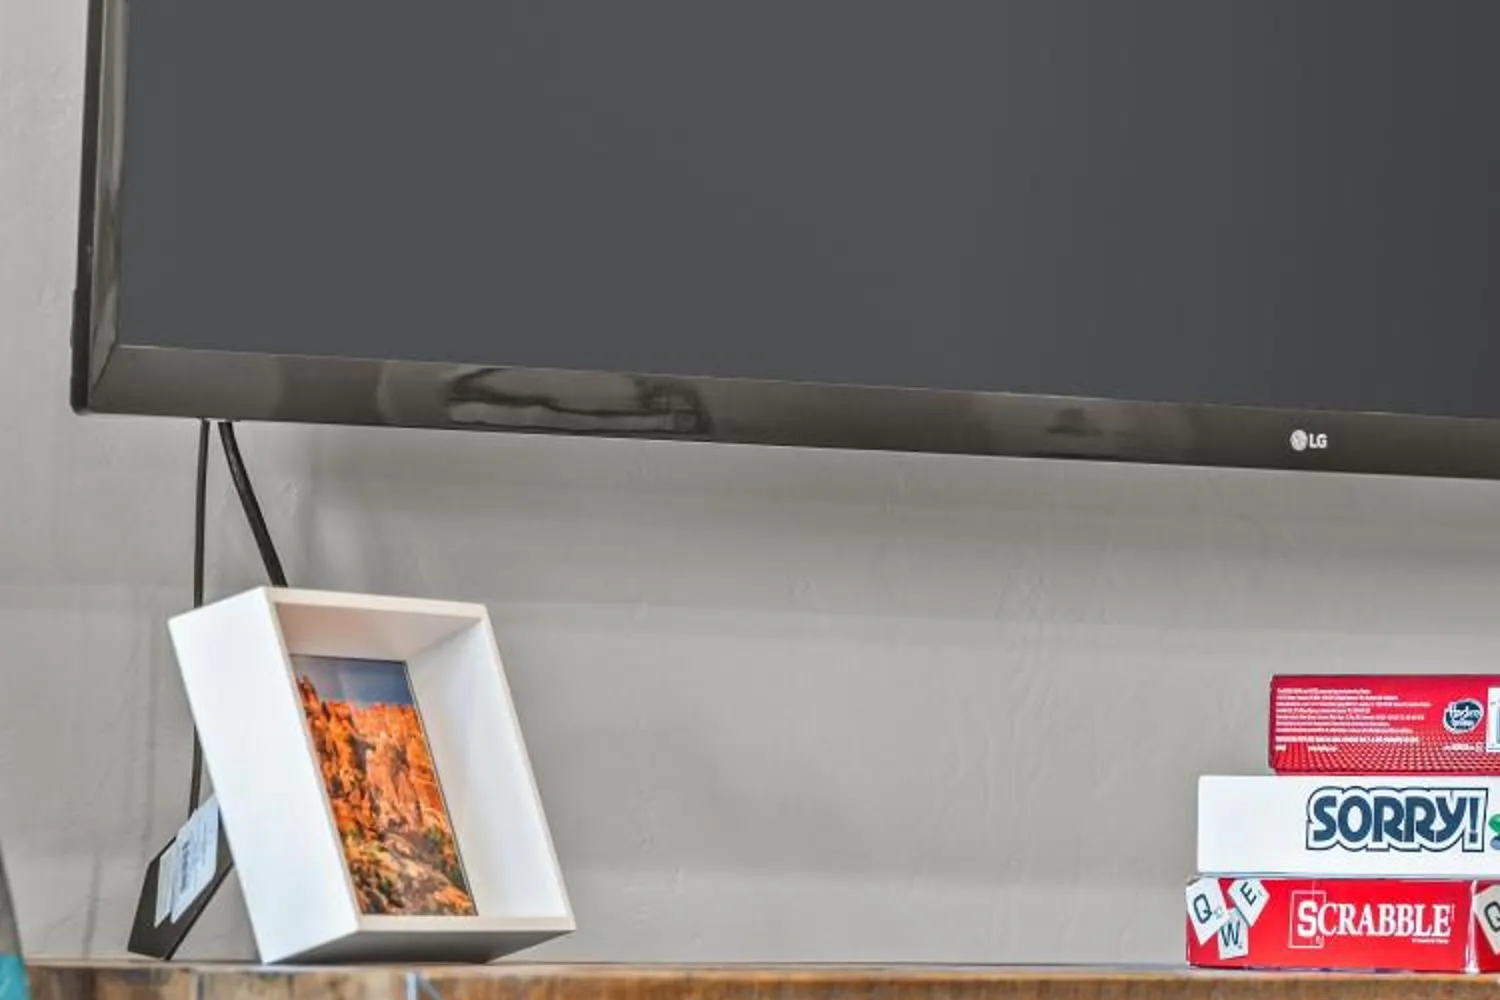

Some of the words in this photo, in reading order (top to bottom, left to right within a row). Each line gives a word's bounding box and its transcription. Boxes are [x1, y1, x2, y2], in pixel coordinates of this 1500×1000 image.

[1309, 433, 1328, 449] LG
[1310, 792, 1482, 846] SORRY!
[1240, 881, 1257, 906] E
[1297, 900, 1451, 938] SCRABBLE
[1220, 920, 1242, 946] W
